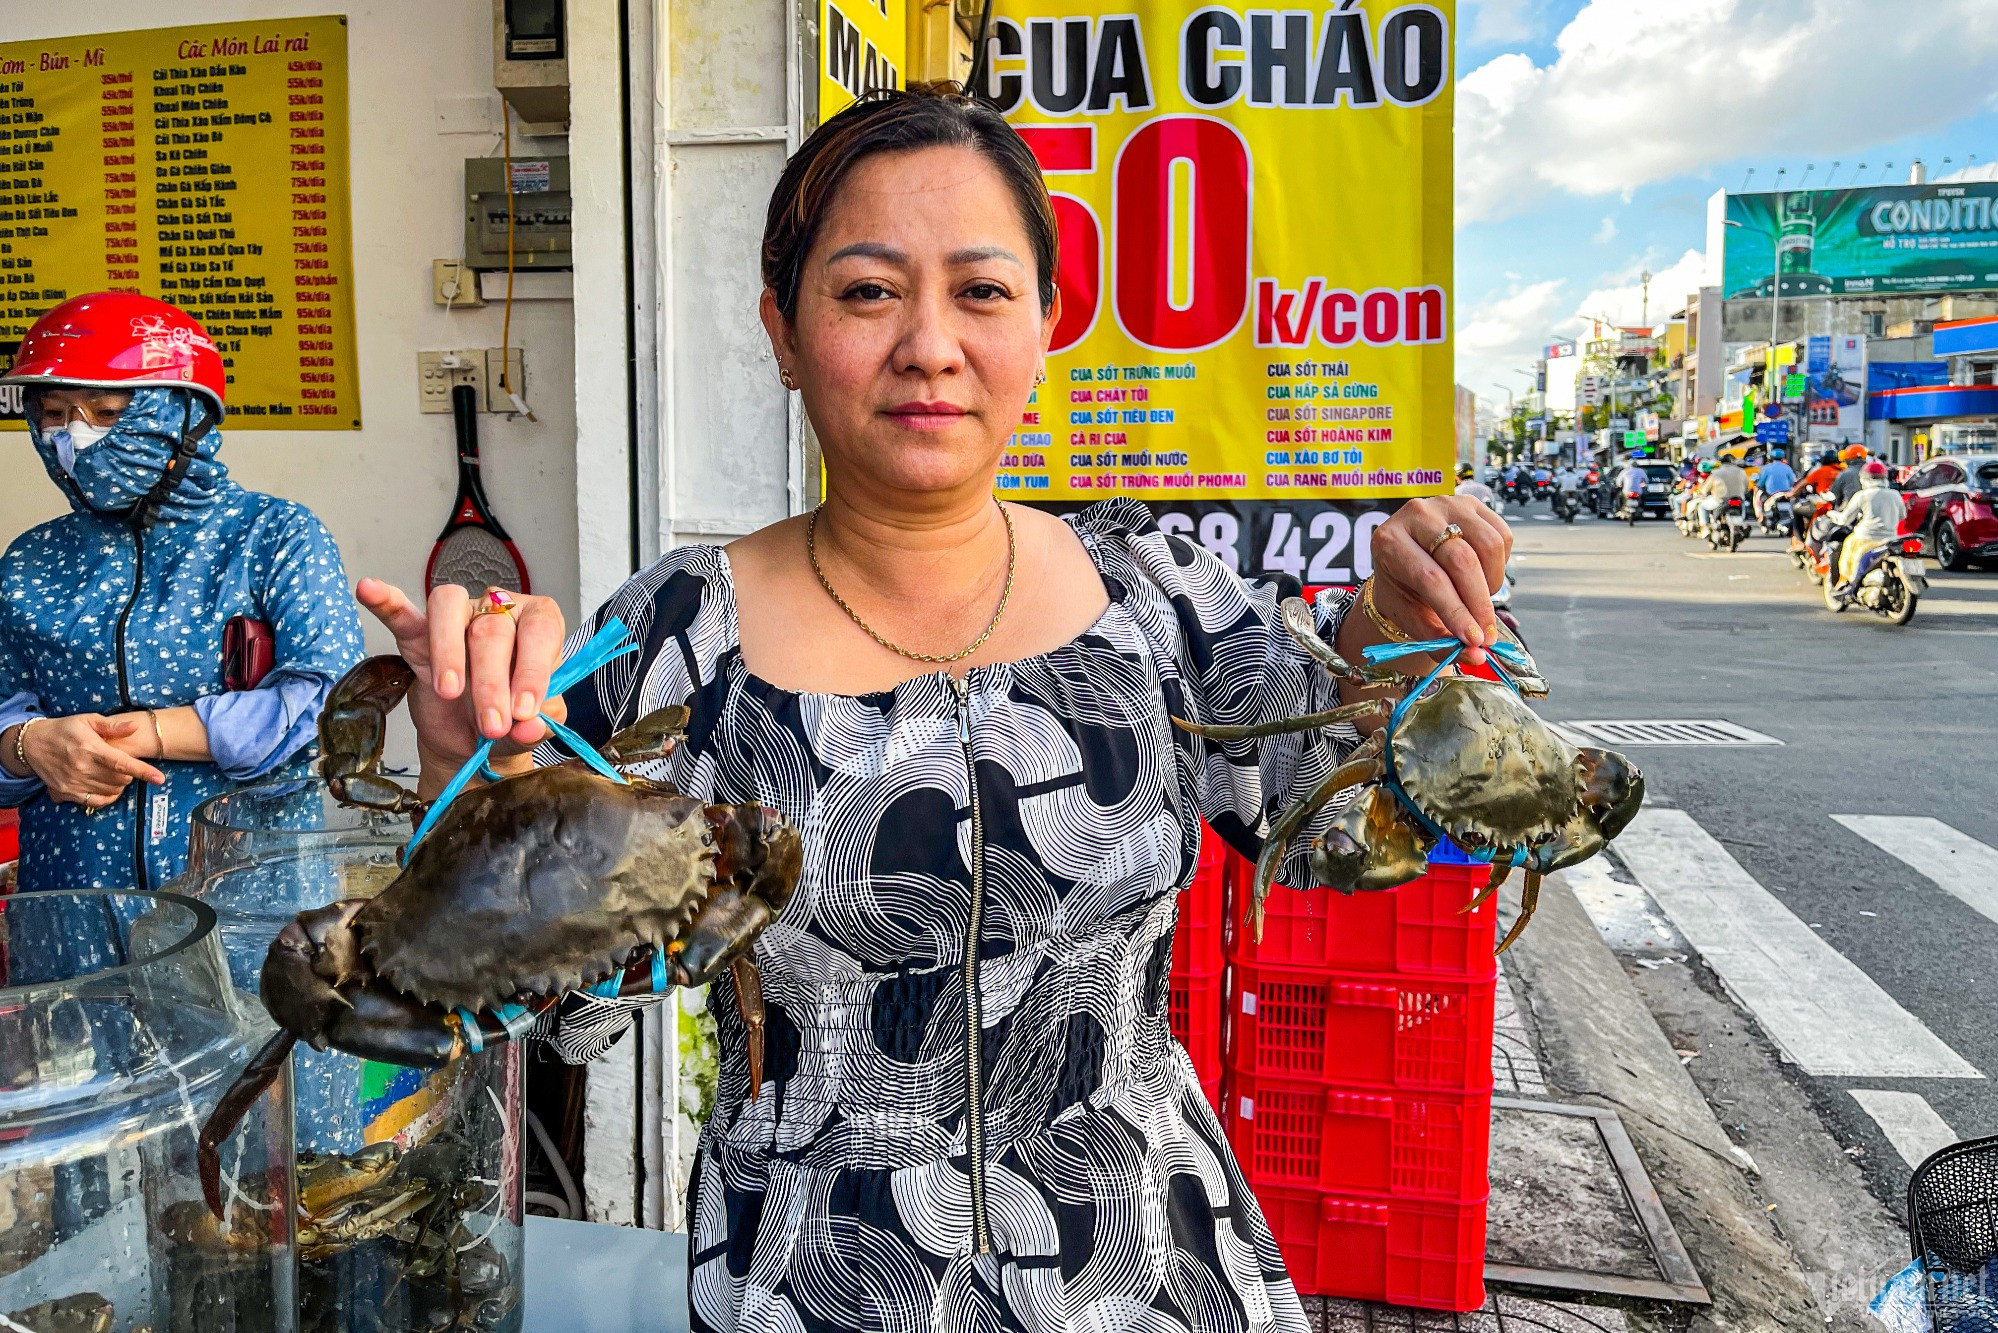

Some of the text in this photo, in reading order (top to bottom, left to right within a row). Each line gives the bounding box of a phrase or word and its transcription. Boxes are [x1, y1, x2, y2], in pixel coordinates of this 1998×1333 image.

[178, 32, 310, 60] Các Món Lai rai
[975, 0, 1448, 114] CUA CHÁO
[1070, 361, 1197, 382] CUA SỐT TRỨNG MUỐI
[1268, 363, 1292, 378] CUA
[1295, 359, 1318, 377] SỐT
[1070, 390, 1093, 403] CUA
[1267, 385, 1291, 400] CUA
[1294, 381, 1319, 399] HẤP
[1343, 382, 1378, 399] GỪNG
[1070, 407, 1175, 425] CUA SỐT TIÊU ĐEN
[1267, 404, 1392, 421] CUA SỐT SINGAPORE
[1089, 432, 1101, 446] RI
[1104, 432, 1127, 446] CUA
[1267, 425, 1392, 443] CUA SỐT HOÀNG KIM
[1070, 450, 1188, 467] CUA SỐT MUỐI NƯỚC
[1266, 451, 1290, 465] CUA
[1294, 449, 1319, 465] XÀO
[1322, 449, 1340, 465] BƠ
[1024, 475, 1050, 488] YUM
[1070, 470, 1246, 489] CUA SỐT TRỨNG MUỐI PHOMAI
[1266, 467, 1442, 487] CUA RANG MUỐI HỒNG KÔNG
